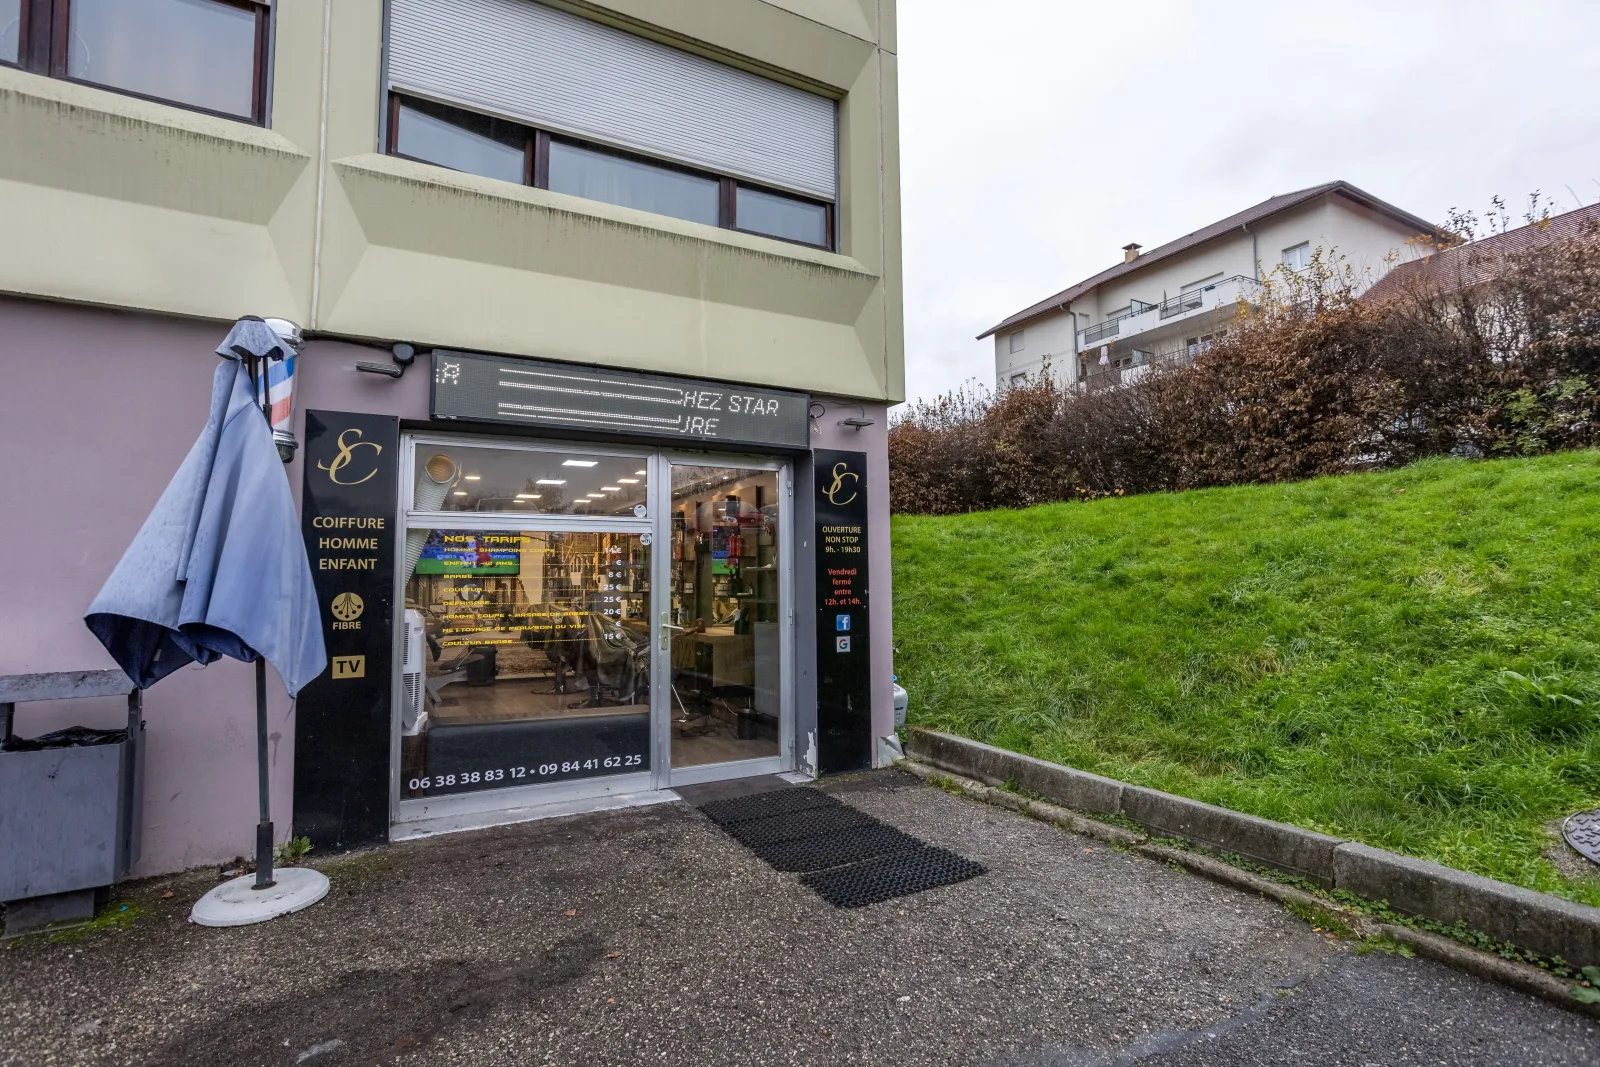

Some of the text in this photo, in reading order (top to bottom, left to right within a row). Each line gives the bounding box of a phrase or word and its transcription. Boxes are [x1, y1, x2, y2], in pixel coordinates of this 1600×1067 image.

[728, 395, 779, 417] STAR
[312, 516, 385, 530] COIFFURE
[822, 525, 862, 534] OUVERTURE
[319, 537, 379, 550] HOMME
[444, 535, 476, 543] NOS
[482, 536, 531, 544] TARIFS
[825, 536, 859, 544] NON STOP
[319, 558, 377, 570] ENFANT
[832, 578, 852, 586] fermé
[825, 598, 839, 606] 12h.
[332, 621, 361, 630] FIBRE
[335, 659, 361, 674] TV
[408, 777, 432, 790] 06
[434, 774, 457, 787] 38
[459, 771, 481, 785] 38
[484, 769, 505, 781] 83
[508, 766, 526, 778] 12
[538, 763, 558, 775] 09
[561, 761, 581, 773] 84
[583, 758, 600, 770] 41
[603, 756, 622, 768] 62
[624, 754, 643, 765] 25
